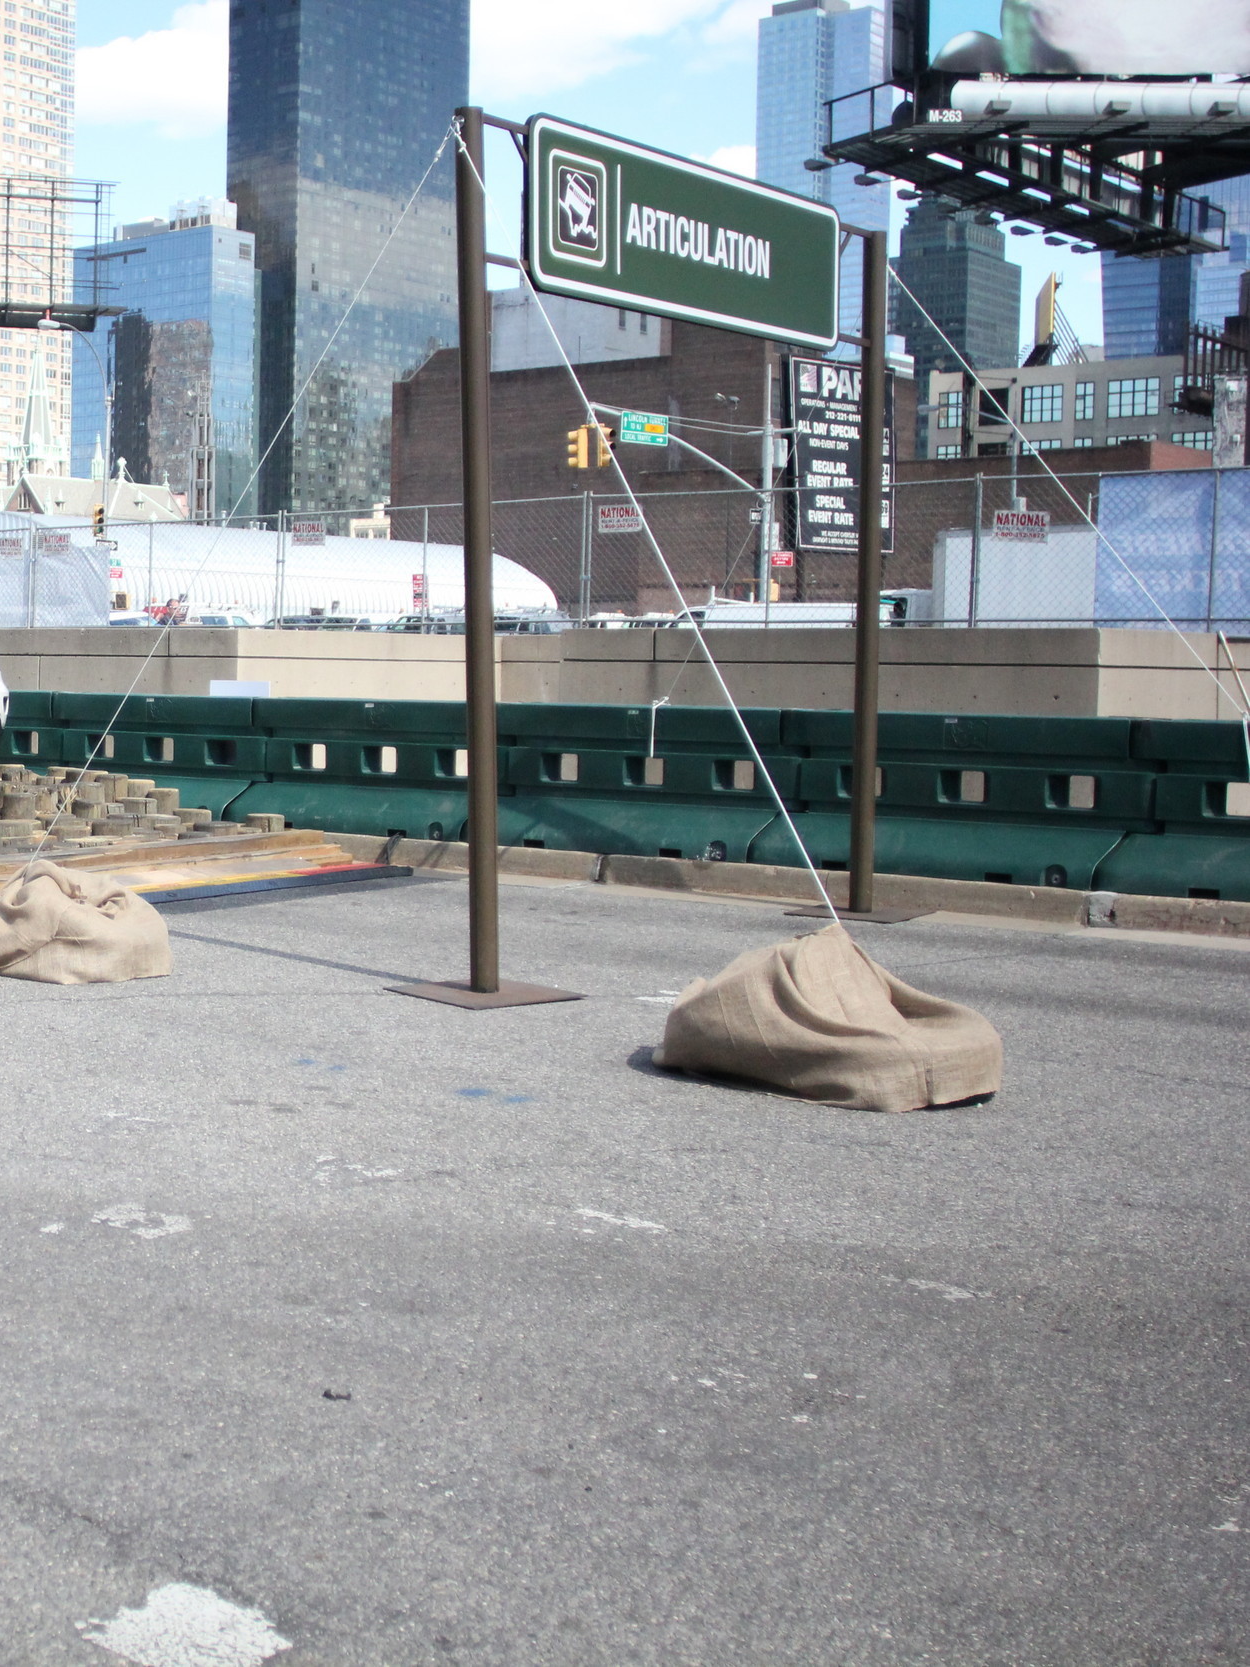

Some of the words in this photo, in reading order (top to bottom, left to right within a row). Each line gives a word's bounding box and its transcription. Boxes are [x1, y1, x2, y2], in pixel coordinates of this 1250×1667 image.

[929, 109, 962, 123] M-263
[626, 203, 770, 279] ARTICULATION
[797, 419, 812, 434] ALL
[812, 421, 828, 436] DAY
[829, 423, 860, 440] SPECIAL
[812, 460, 847, 475] REGULAR
[807, 474, 832, 488] EVENT
[833, 476, 854, 487] RATE
[815, 495, 846, 510] SPECIAL
[600, 507, 639, 518] NATIONAL
[808, 509, 833, 524] EVENT
[833, 512, 854, 526] RATE
[997, 513, 1046, 527] NATIONAL
